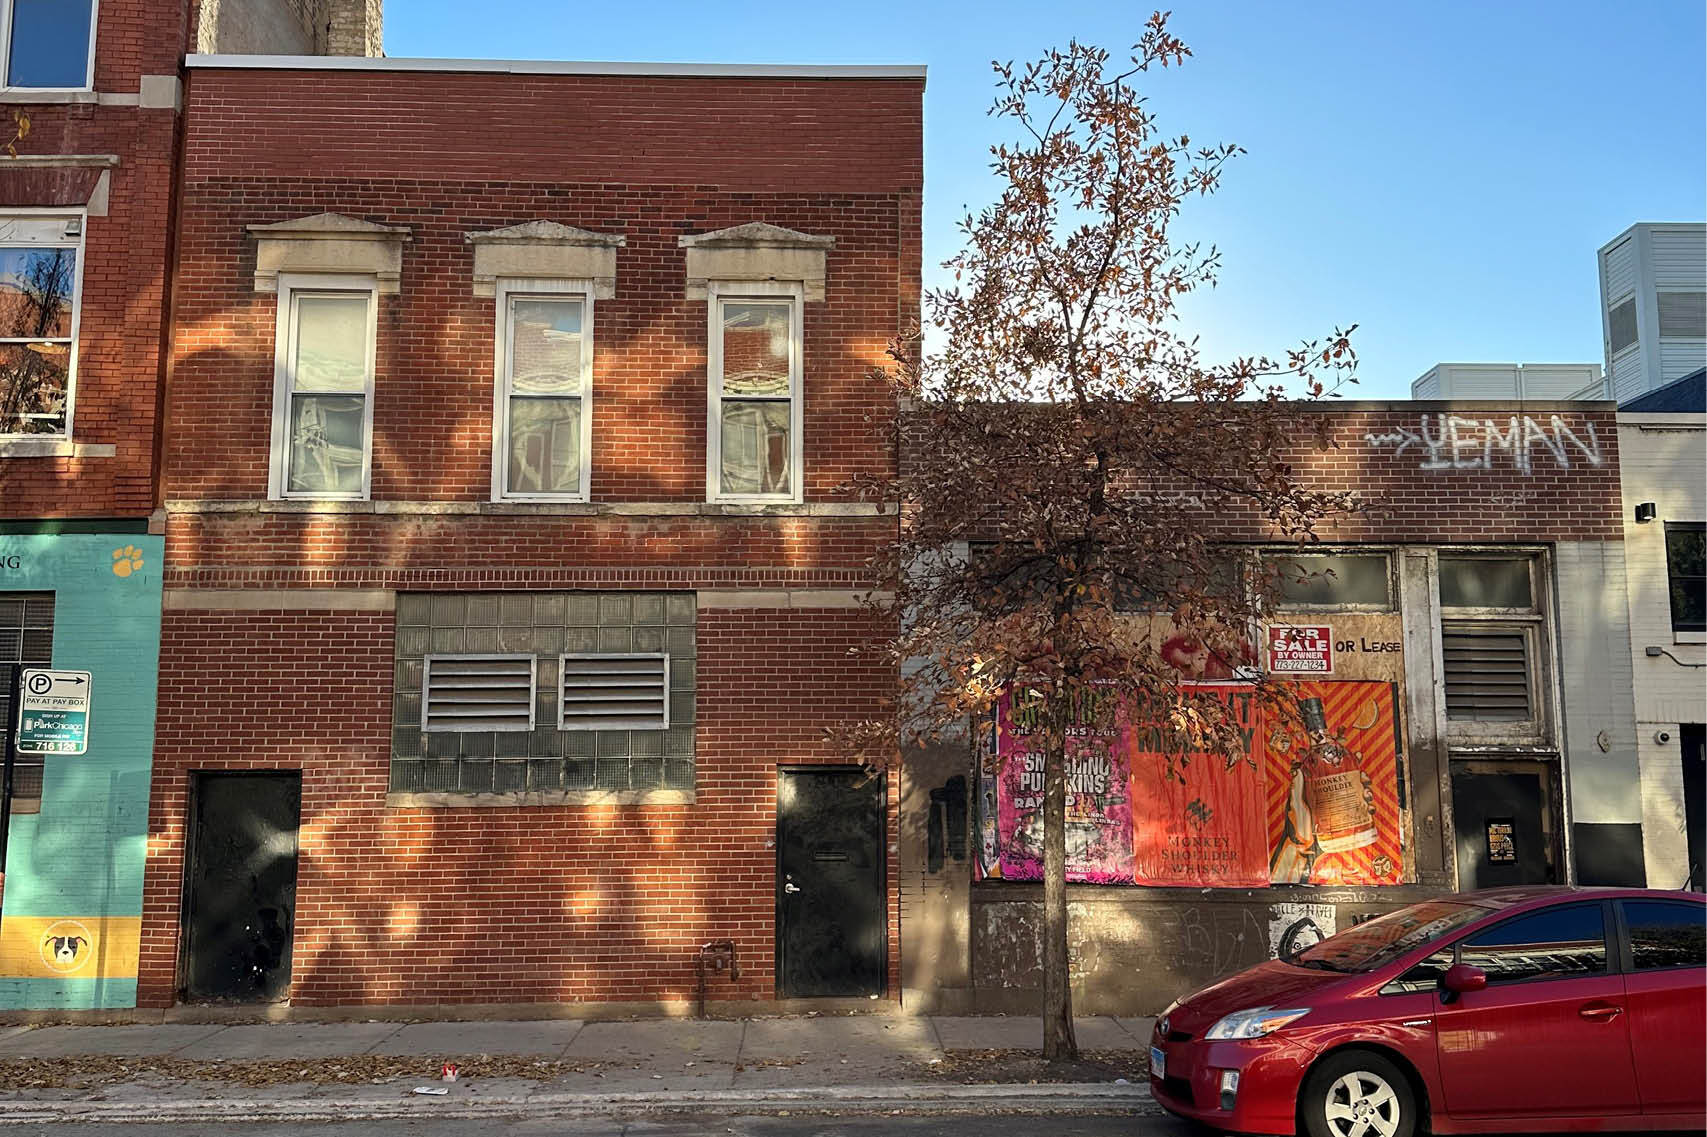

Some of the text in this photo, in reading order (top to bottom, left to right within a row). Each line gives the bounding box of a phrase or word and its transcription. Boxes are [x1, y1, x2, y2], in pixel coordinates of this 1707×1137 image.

[1274, 640, 1328, 652] SALE
[1336, 641, 1355, 653] OR
[1020, 773, 1105, 793] PUKINS
[1168, 835, 1229, 848] MONKEY
